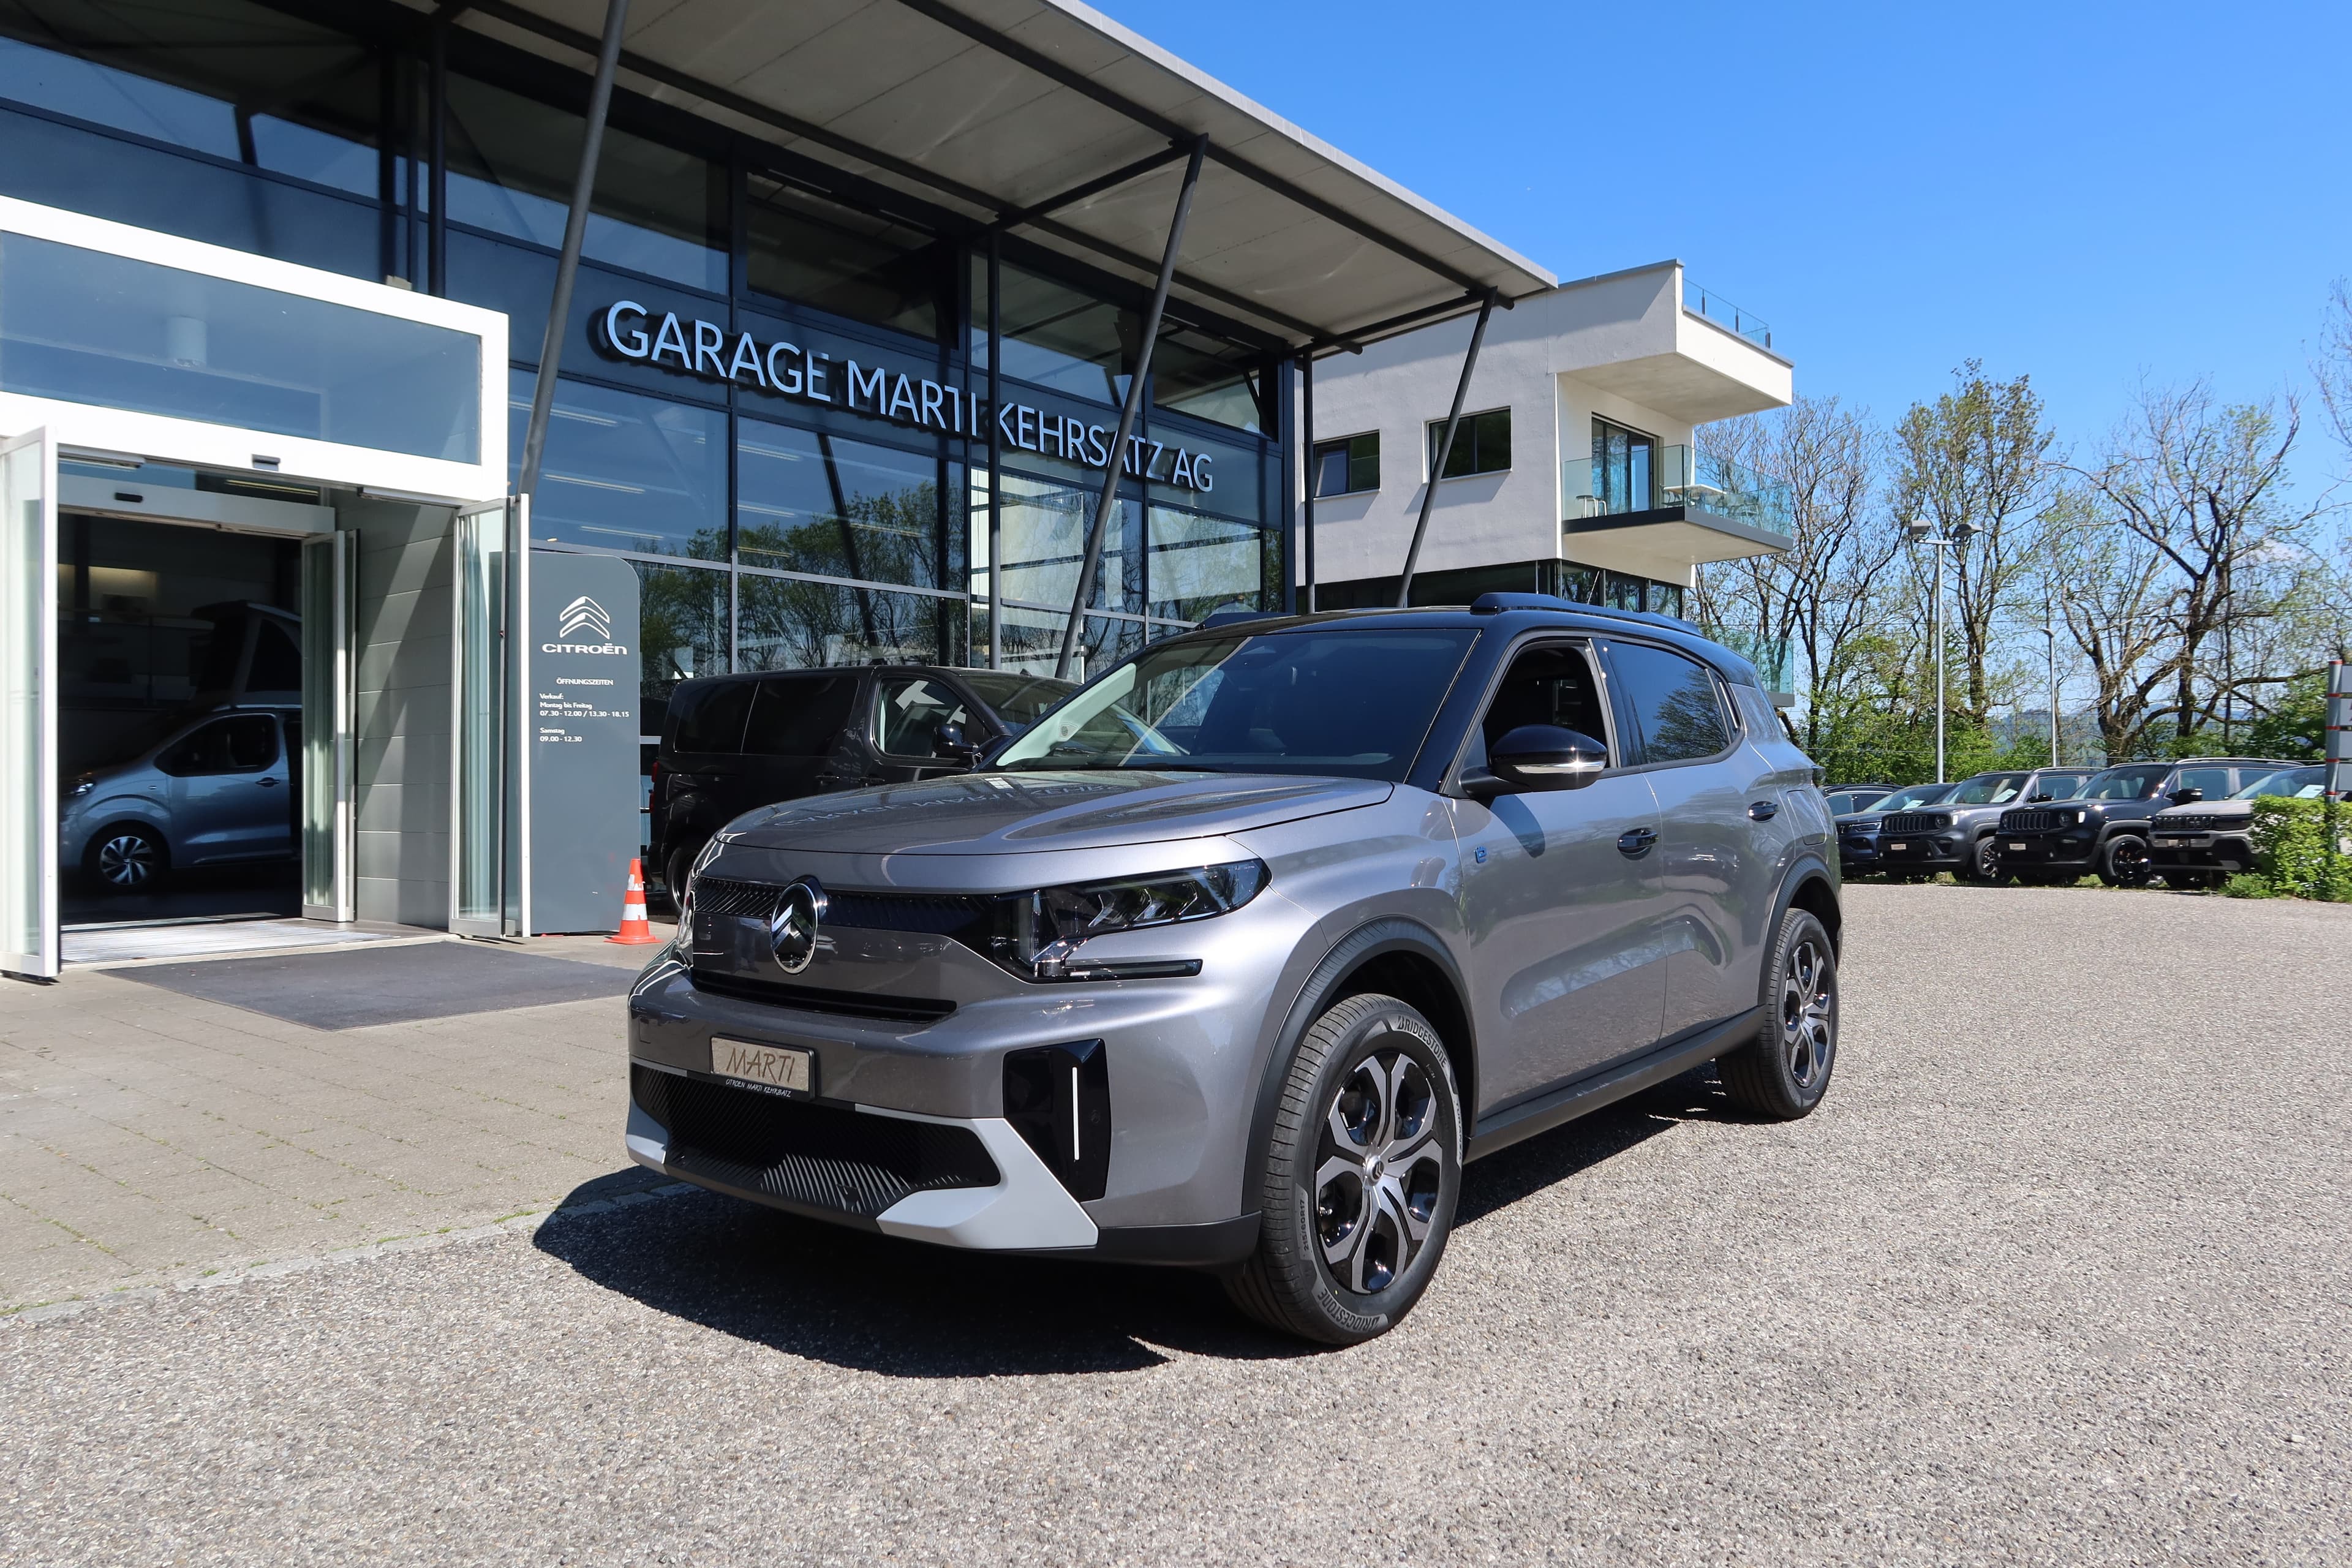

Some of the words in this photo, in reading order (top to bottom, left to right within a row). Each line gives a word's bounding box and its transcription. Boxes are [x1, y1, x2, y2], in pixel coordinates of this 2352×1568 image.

[606, 300, 831, 402] GARAGE
[848, 360, 978, 436] MARTI
[1172, 448, 1213, 492] AG
[556, 677, 614, 685] ÖFFNUNGSZEITEN
[726, 1047, 796, 1084] MARTI
[1396, 1015, 1447, 1068] BRIDGESTONE
[1300, 1199, 1309, 1251] 215/60R17
[1317, 1288, 1381, 1332] BRIDGESTONE
